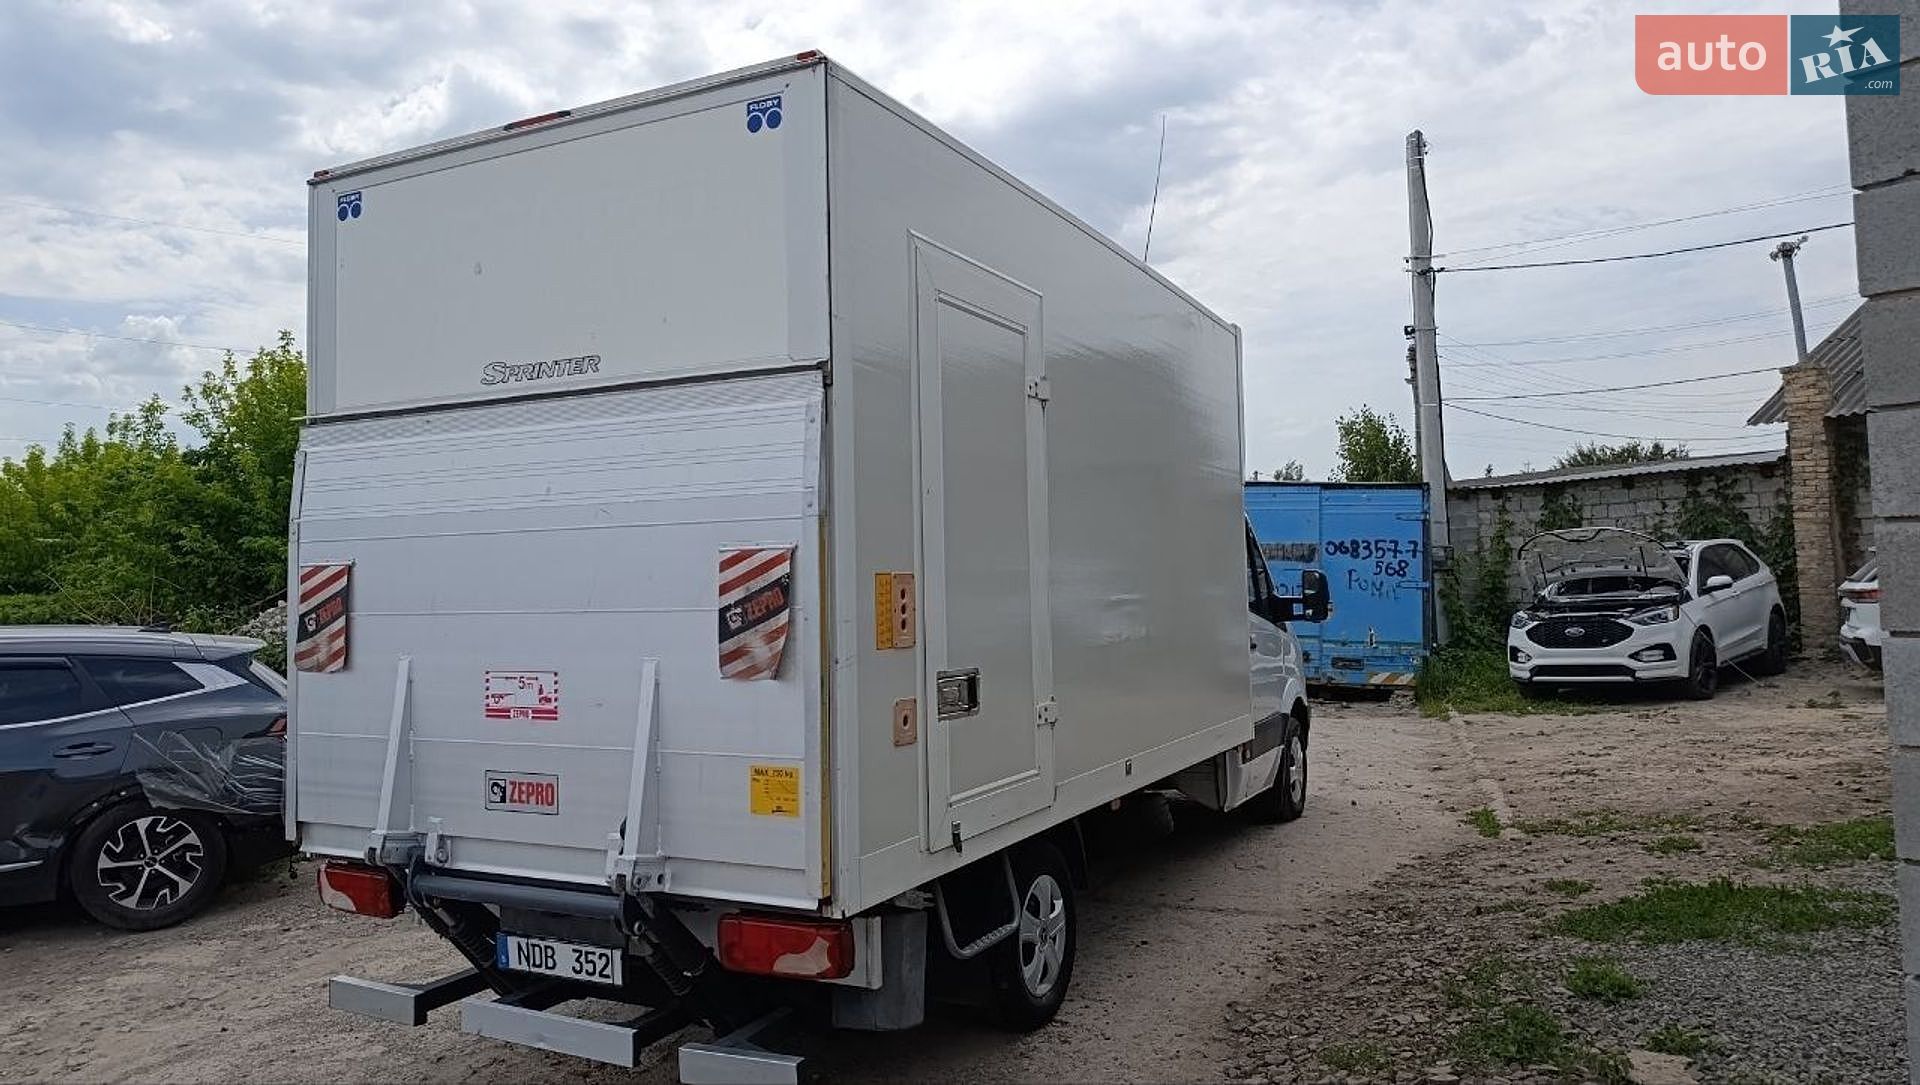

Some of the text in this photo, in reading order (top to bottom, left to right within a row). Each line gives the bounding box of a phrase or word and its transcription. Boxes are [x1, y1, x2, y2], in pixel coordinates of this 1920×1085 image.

[1373, 559, 1410, 578] 568
[508, 780, 556, 807] ZEPRO
[517, 941, 612, 979] NDB 352
